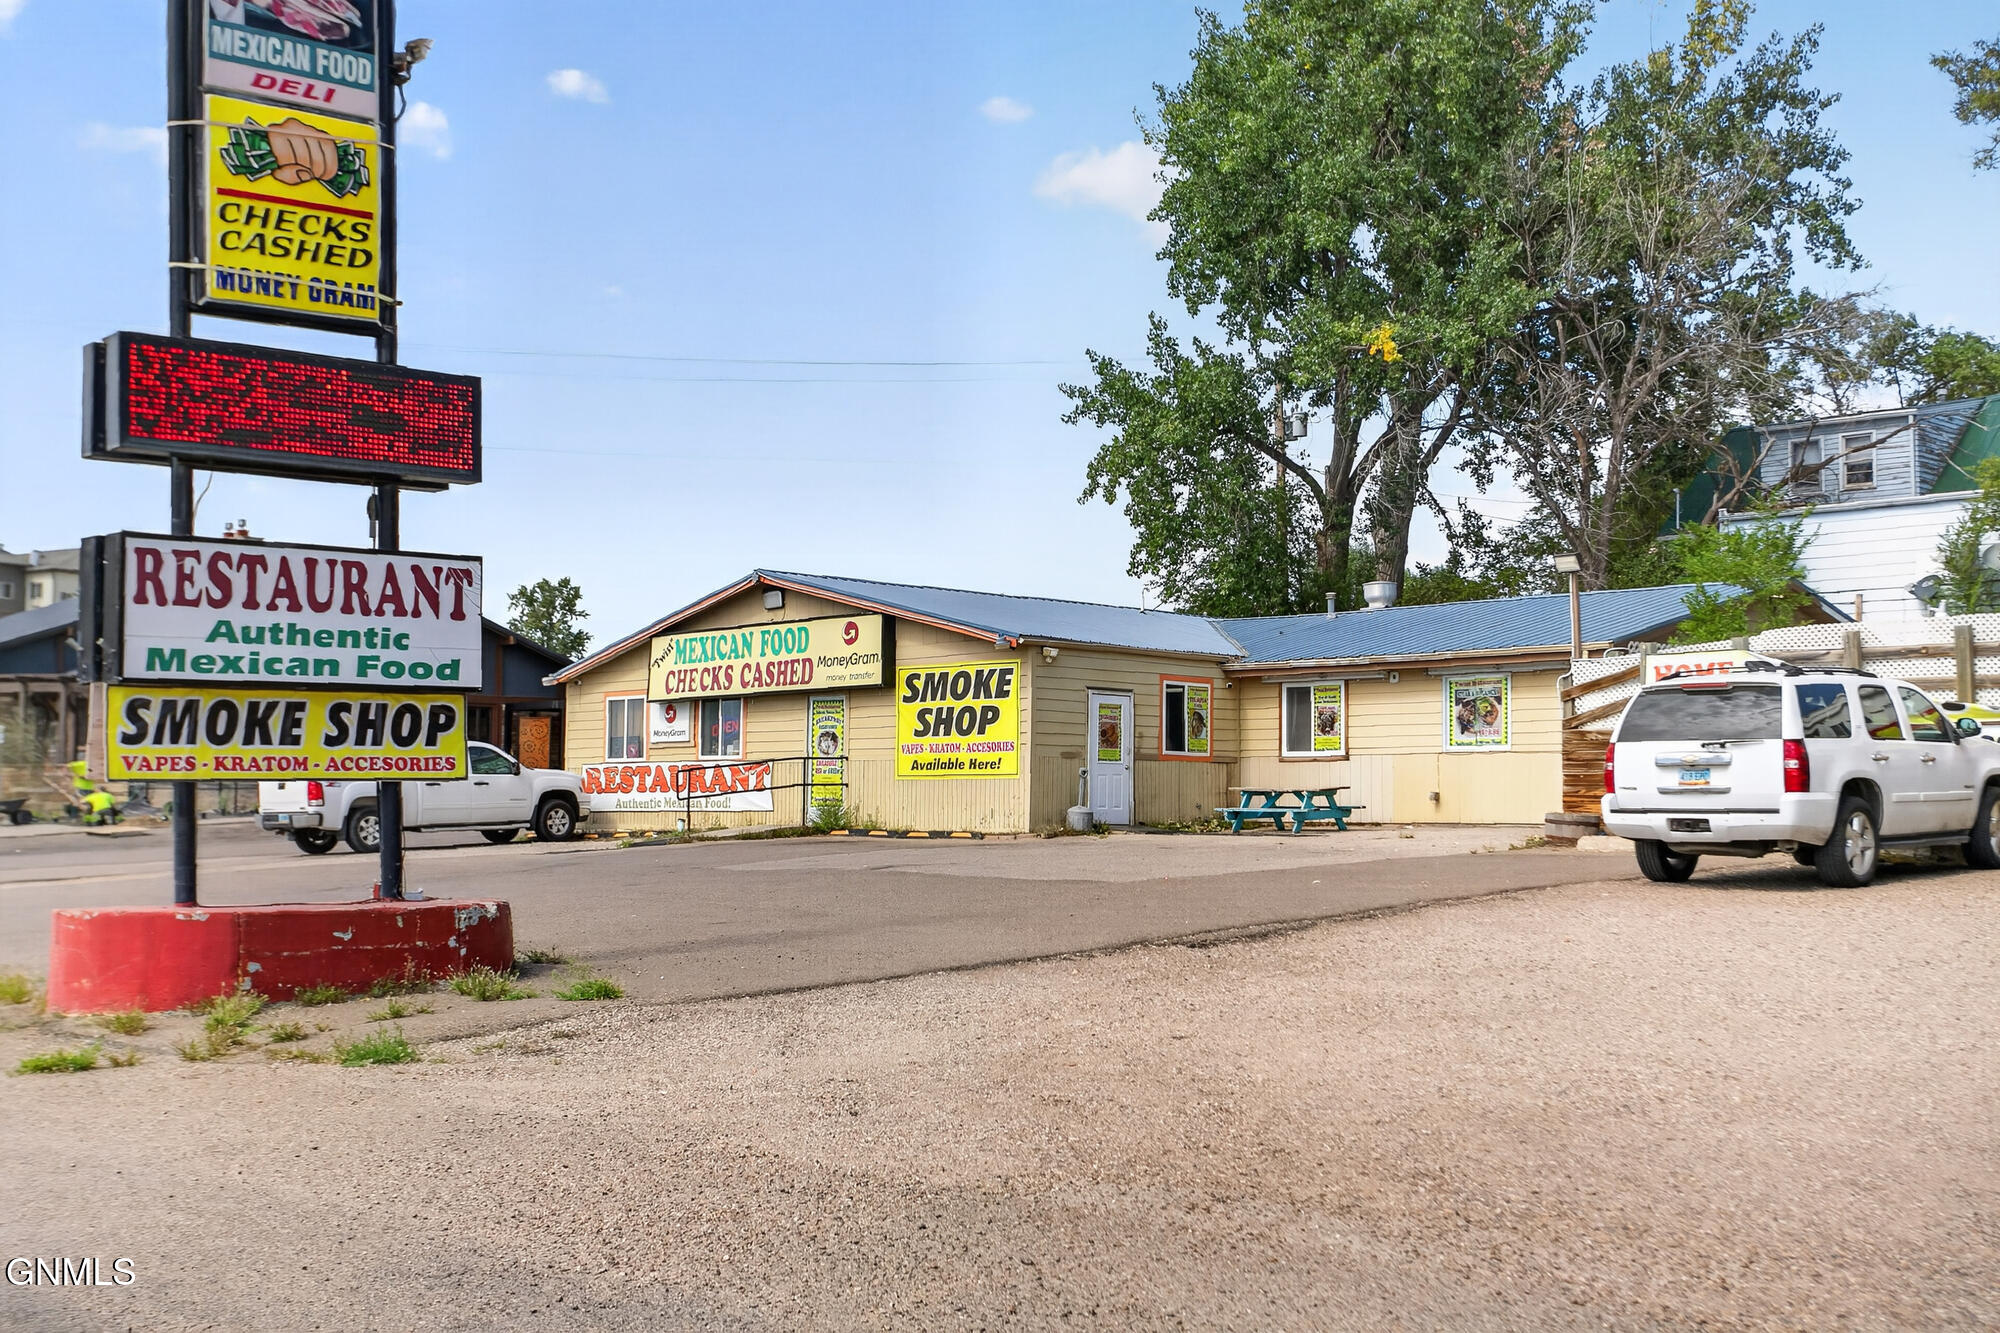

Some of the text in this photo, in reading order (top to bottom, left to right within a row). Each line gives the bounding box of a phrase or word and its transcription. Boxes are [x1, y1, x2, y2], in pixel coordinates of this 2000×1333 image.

[211, 25, 372, 85] MEXICAN FOOD
[251, 73, 336, 103] DELI
[219, 203, 371, 242] CHECKS
[220, 231, 373, 268] CASHED
[216, 265, 375, 310] MONEY GRAM
[133, 547, 473, 621] RESTAURANT
[206, 620, 410, 650] Authentic
[674, 626, 809, 665] MEXICAN FOOD
[146, 648, 461, 681] Mexican Food
[665, 657, 814, 695] CHECKS CASHED
[849, 672, 875, 681] transfer
[902, 668, 1014, 704] SMOKE
[121, 697, 456, 748] SMOKE SHOP
[653, 729, 686, 738] MoneyGram
[712, 720, 738, 737] OEN
[913, 705, 1000, 737] SHOP
[121, 756, 196, 772] VAPES
[214, 756, 309, 772] KRATOM
[325, 756, 456, 772] ACCESORIES
[902, 744, 924, 755] VAPES
[929, 743, 960, 754] KRATOM
[966, 741, 1015, 753] ACCESORIES
[911, 757, 1002, 771] Available Here!
[585, 763, 770, 795] RESTAURANT
[615, 798, 662, 809] Authentic
[705, 796, 731, 808] Food!
